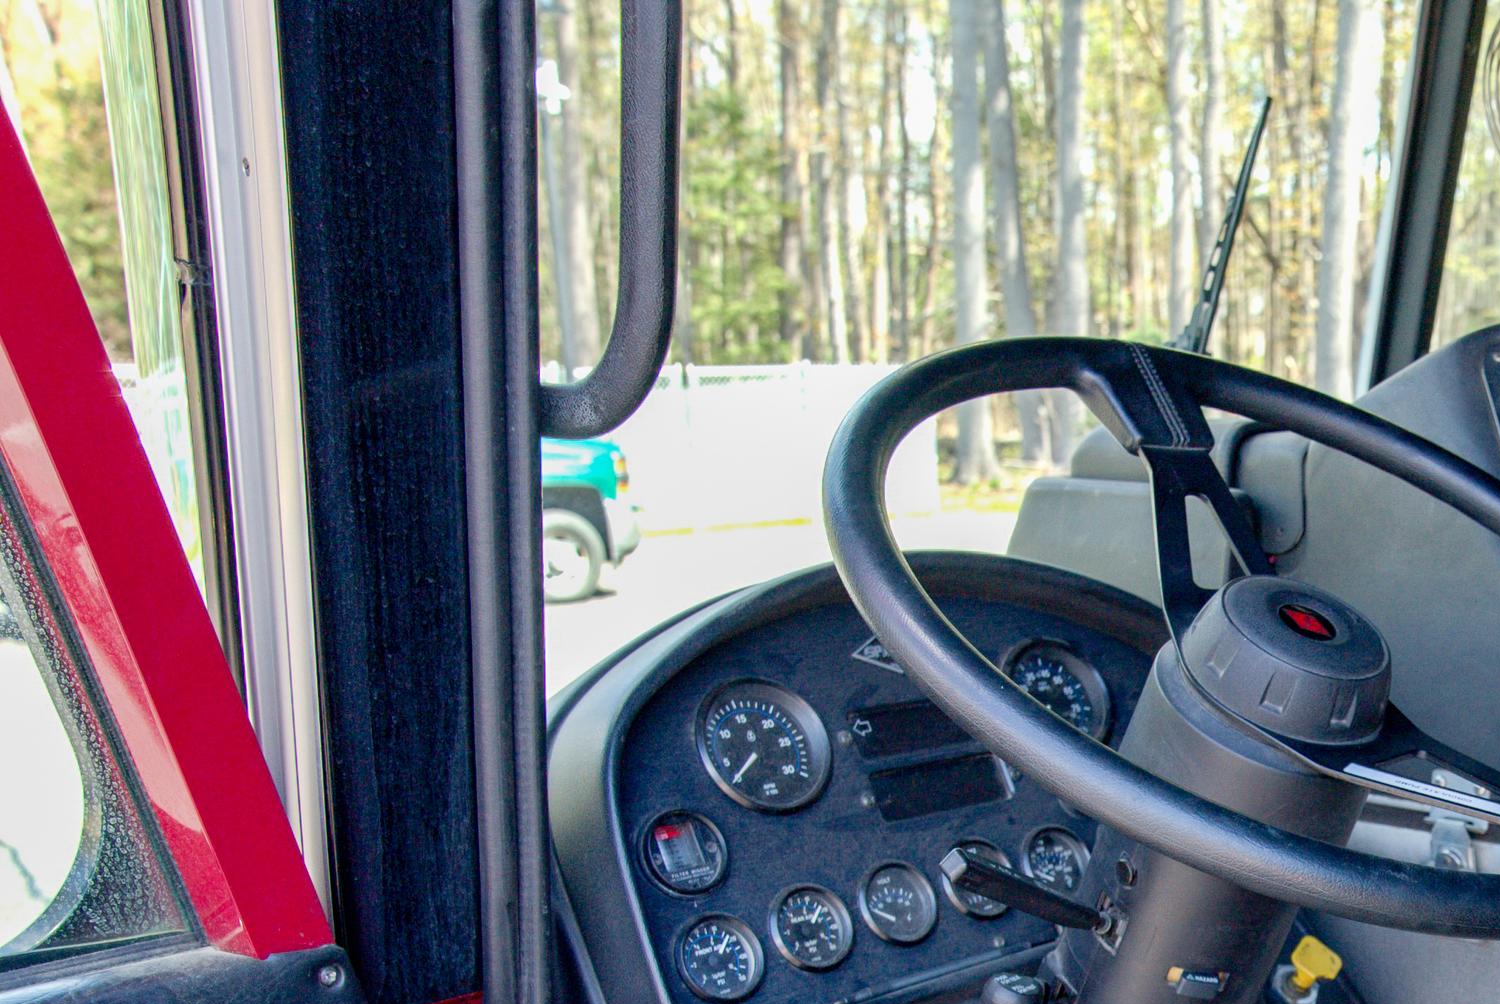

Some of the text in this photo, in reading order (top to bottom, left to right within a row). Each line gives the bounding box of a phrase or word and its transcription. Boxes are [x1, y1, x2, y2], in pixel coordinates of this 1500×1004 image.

[735, 714, 747, 724] 15
[761, 719, 775, 729] 20
[719, 729, 731, 739] 10
[778, 737, 791, 747] 25
[723, 758, 731, 767] 5
[781, 765, 795, 775] 30
